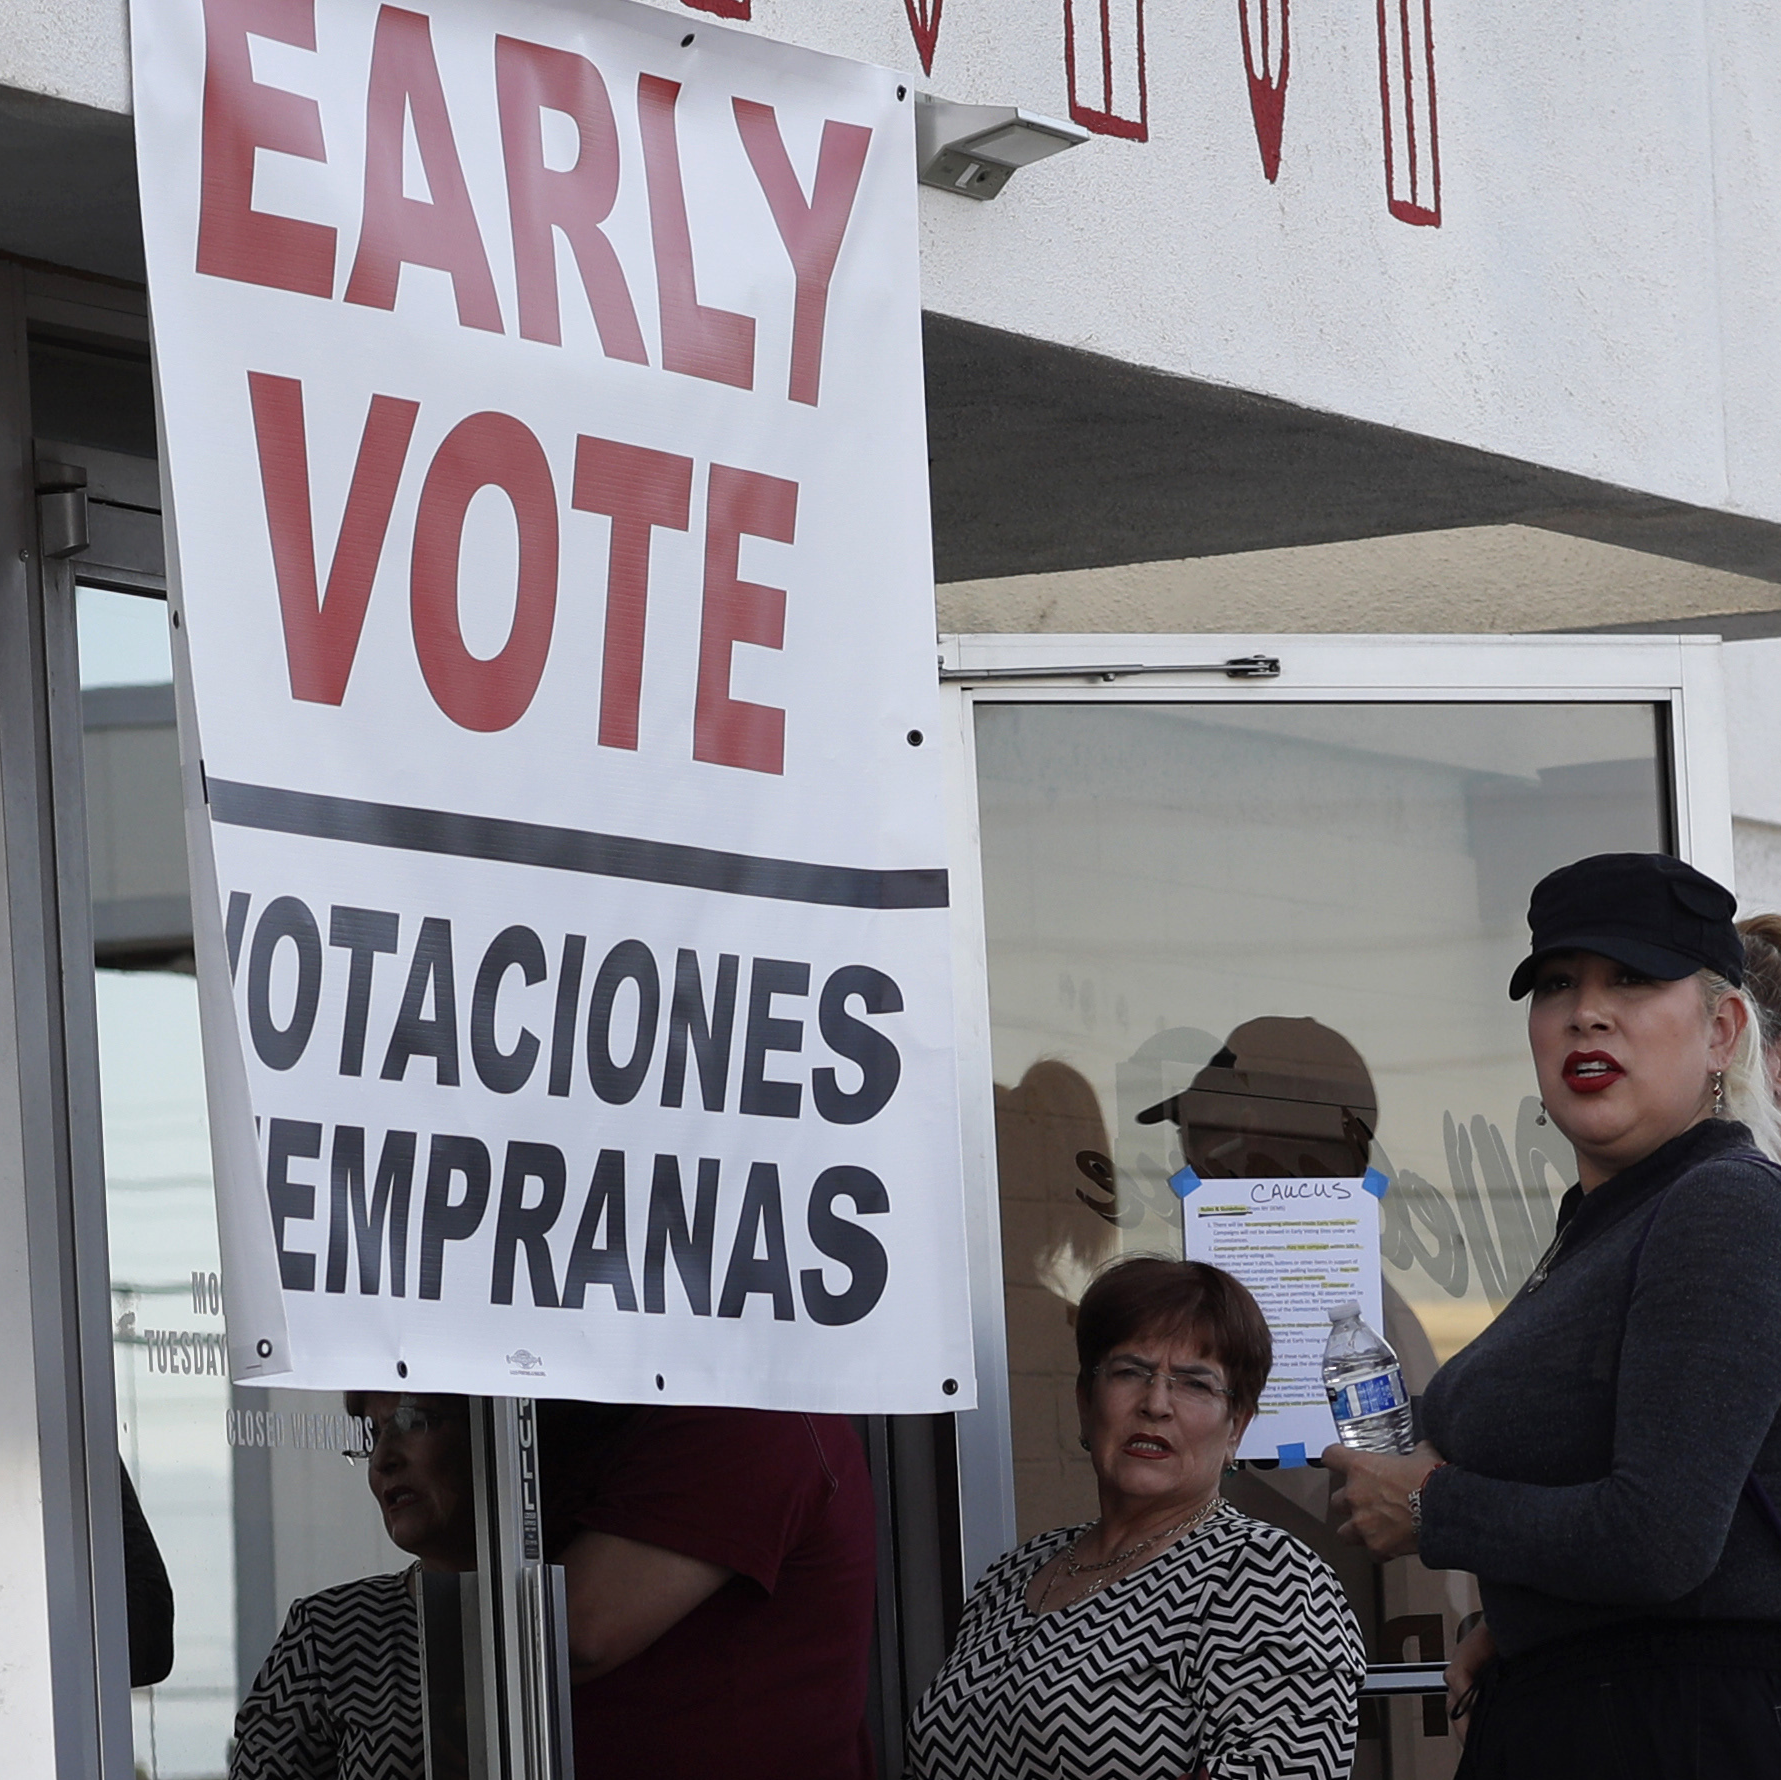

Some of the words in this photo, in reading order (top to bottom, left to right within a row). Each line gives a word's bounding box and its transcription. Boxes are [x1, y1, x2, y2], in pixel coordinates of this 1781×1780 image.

[195, 0, 874, 408] EARLY
[246, 369, 800, 775] VOTE
[255, 1114, 891, 1327] EMPRANAS
[1250, 1181, 1353, 1203] CAUCUS
[191, 1271, 226, 1317] MO
[225, 1408, 285, 1449] CLOSED
[291, 1411, 376, 1453] WEEKENDS
